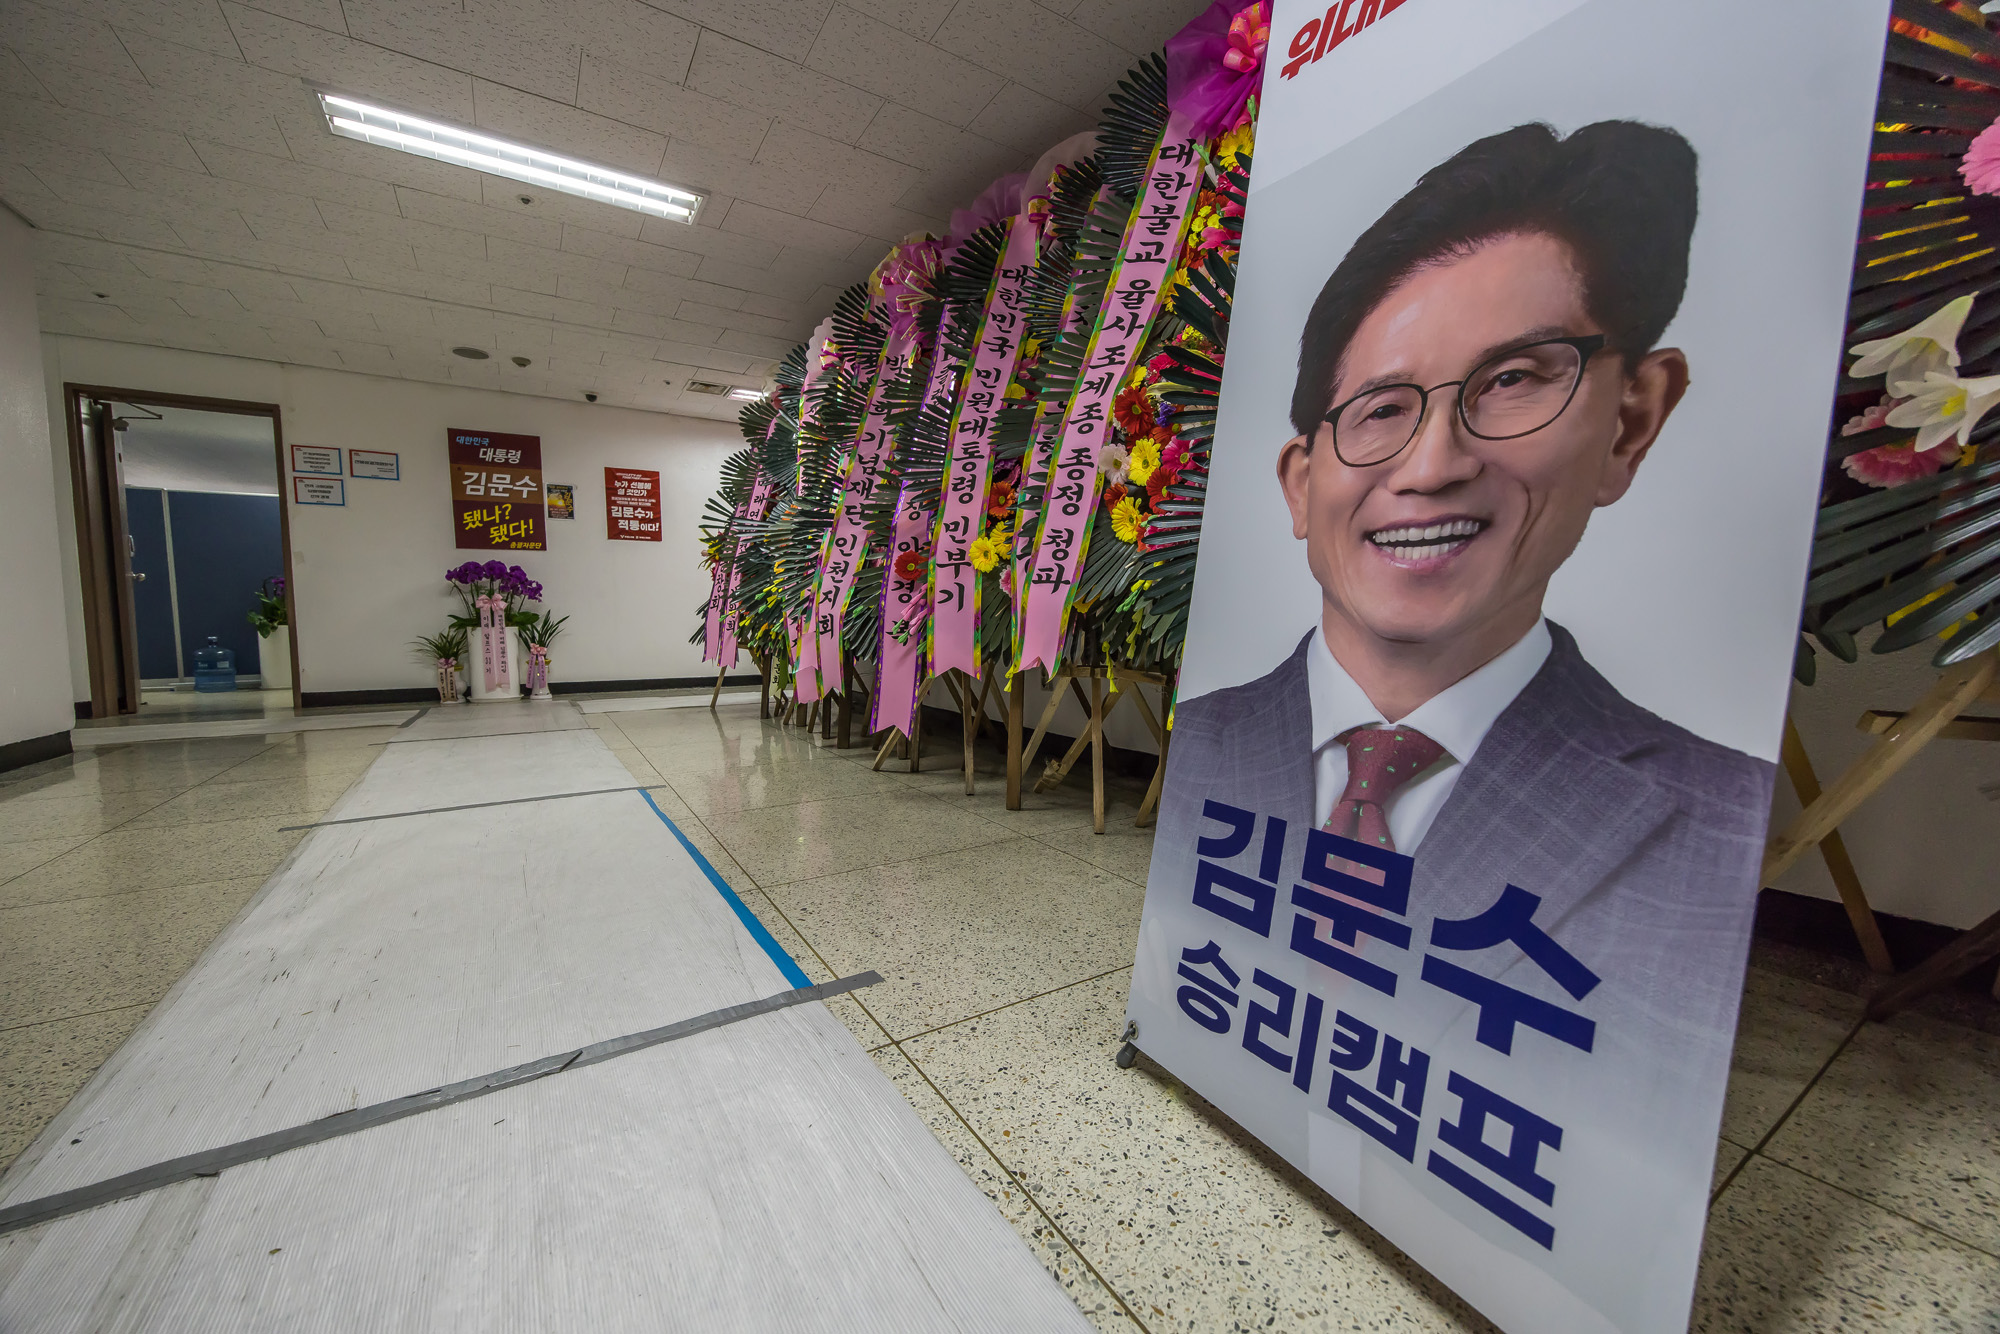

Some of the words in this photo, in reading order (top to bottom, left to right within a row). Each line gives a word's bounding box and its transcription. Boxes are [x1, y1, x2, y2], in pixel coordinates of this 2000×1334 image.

[1125, 138, 1197, 264] 대한불교
[982, 264, 1034, 361] 대한민국
[1068, 278, 1156, 434] 율사조계종
[456, 435, 490, 447] 대한민국
[479, 447, 522, 464] 대통령
[951, 367, 1002, 504] 민원대통령
[462, 472, 538, 499] 김문수
[611, 506, 654, 519] 김문수가
[1051, 447, 1095, 516] 종정
[462, 503, 512, 530] 됐나?
[489, 518, 534, 544] 됐다!
[618, 519, 659, 532] 적통이다!
[817, 533, 857, 640] 인천지회
[936, 515, 975, 612] 민부기
[1032, 527, 1075, 595] 청파
[1192, 798, 1601, 1056] 김문수
[1177, 940, 1564, 1252] 승리캠프
